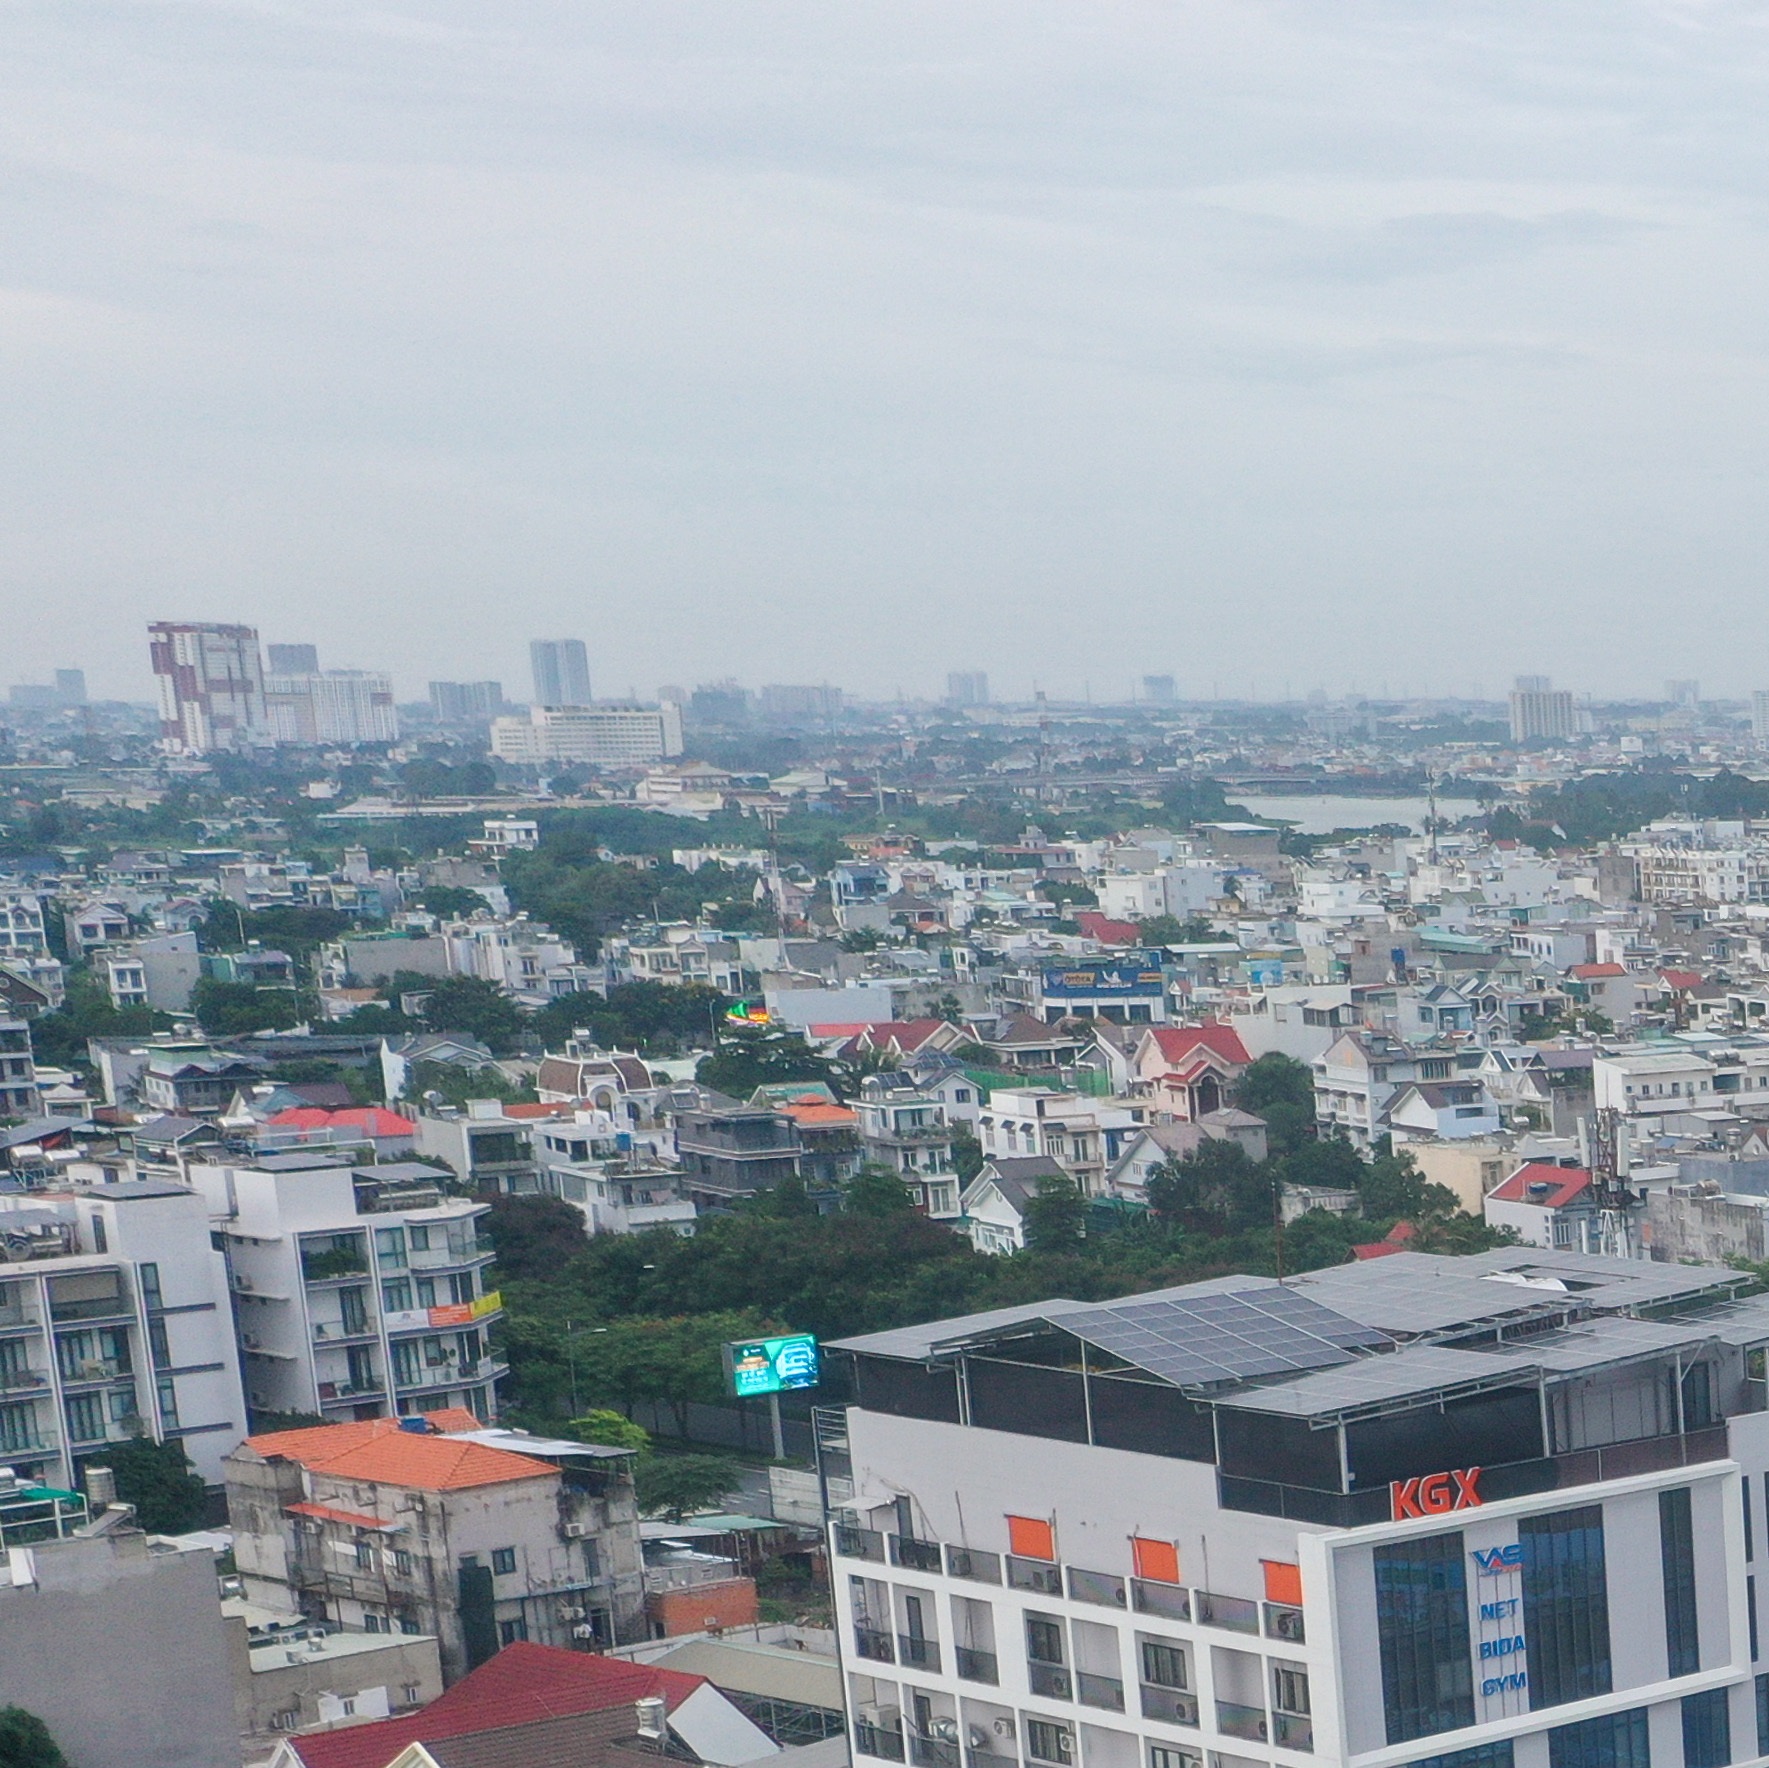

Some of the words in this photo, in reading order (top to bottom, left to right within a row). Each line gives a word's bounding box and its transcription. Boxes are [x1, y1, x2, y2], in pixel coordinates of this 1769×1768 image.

[1390, 1466, 1483, 1522] KGX
[1479, 1598, 1519, 1621] NET
[1479, 1635, 1526, 1660] BIDA
[1482, 1672, 1527, 1696] GYM
